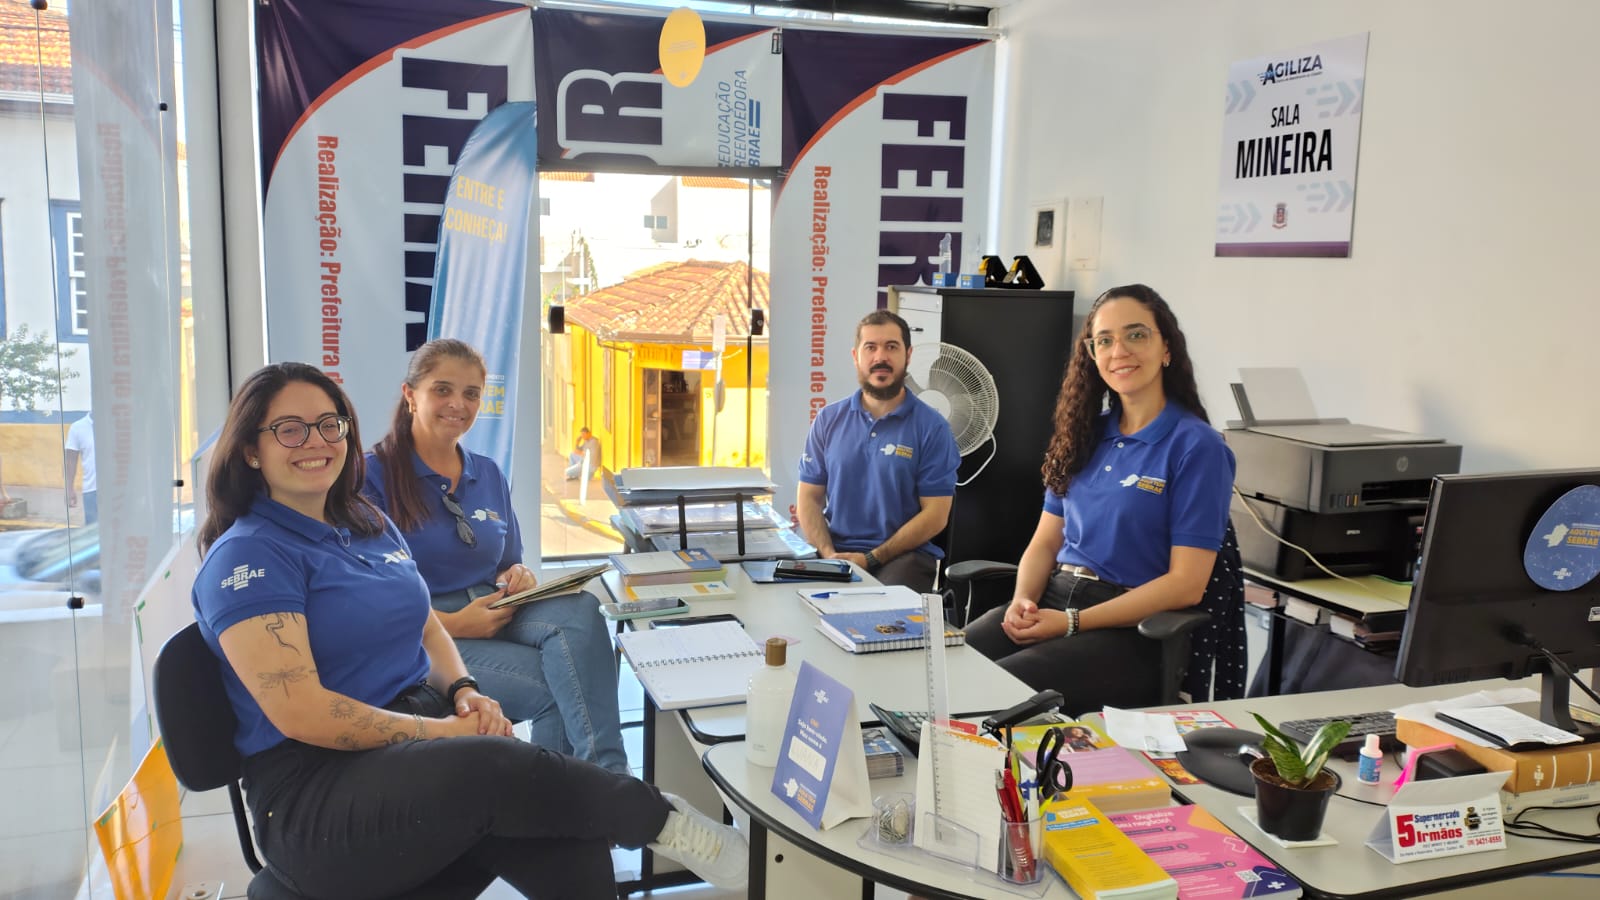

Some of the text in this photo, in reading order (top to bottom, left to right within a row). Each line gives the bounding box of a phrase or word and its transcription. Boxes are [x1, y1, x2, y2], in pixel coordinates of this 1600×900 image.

[1262, 54, 1323, 86] AGILIZA
[715, 81, 733, 164] EDUCAÇÃO
[1270, 104, 1300, 128] SALA
[1235, 128, 1333, 179] MINEIRA
[315, 135, 341, 257] Realização:
[456, 175, 506, 211] ENTRE E
[445, 207, 508, 247] CONHEÇA!
[808, 165, 832, 272] Realização:
[320, 262, 342, 366] Prefeitura
[811, 276, 829, 368] Prefeitura
[810, 371, 827, 393] de
[220, 568, 266, 589] SEBRAE
[1396, 814, 1416, 848] 5
[1414, 809, 1460, 823] Supermercado
[1416, 827, 1463, 843] Irmãos
